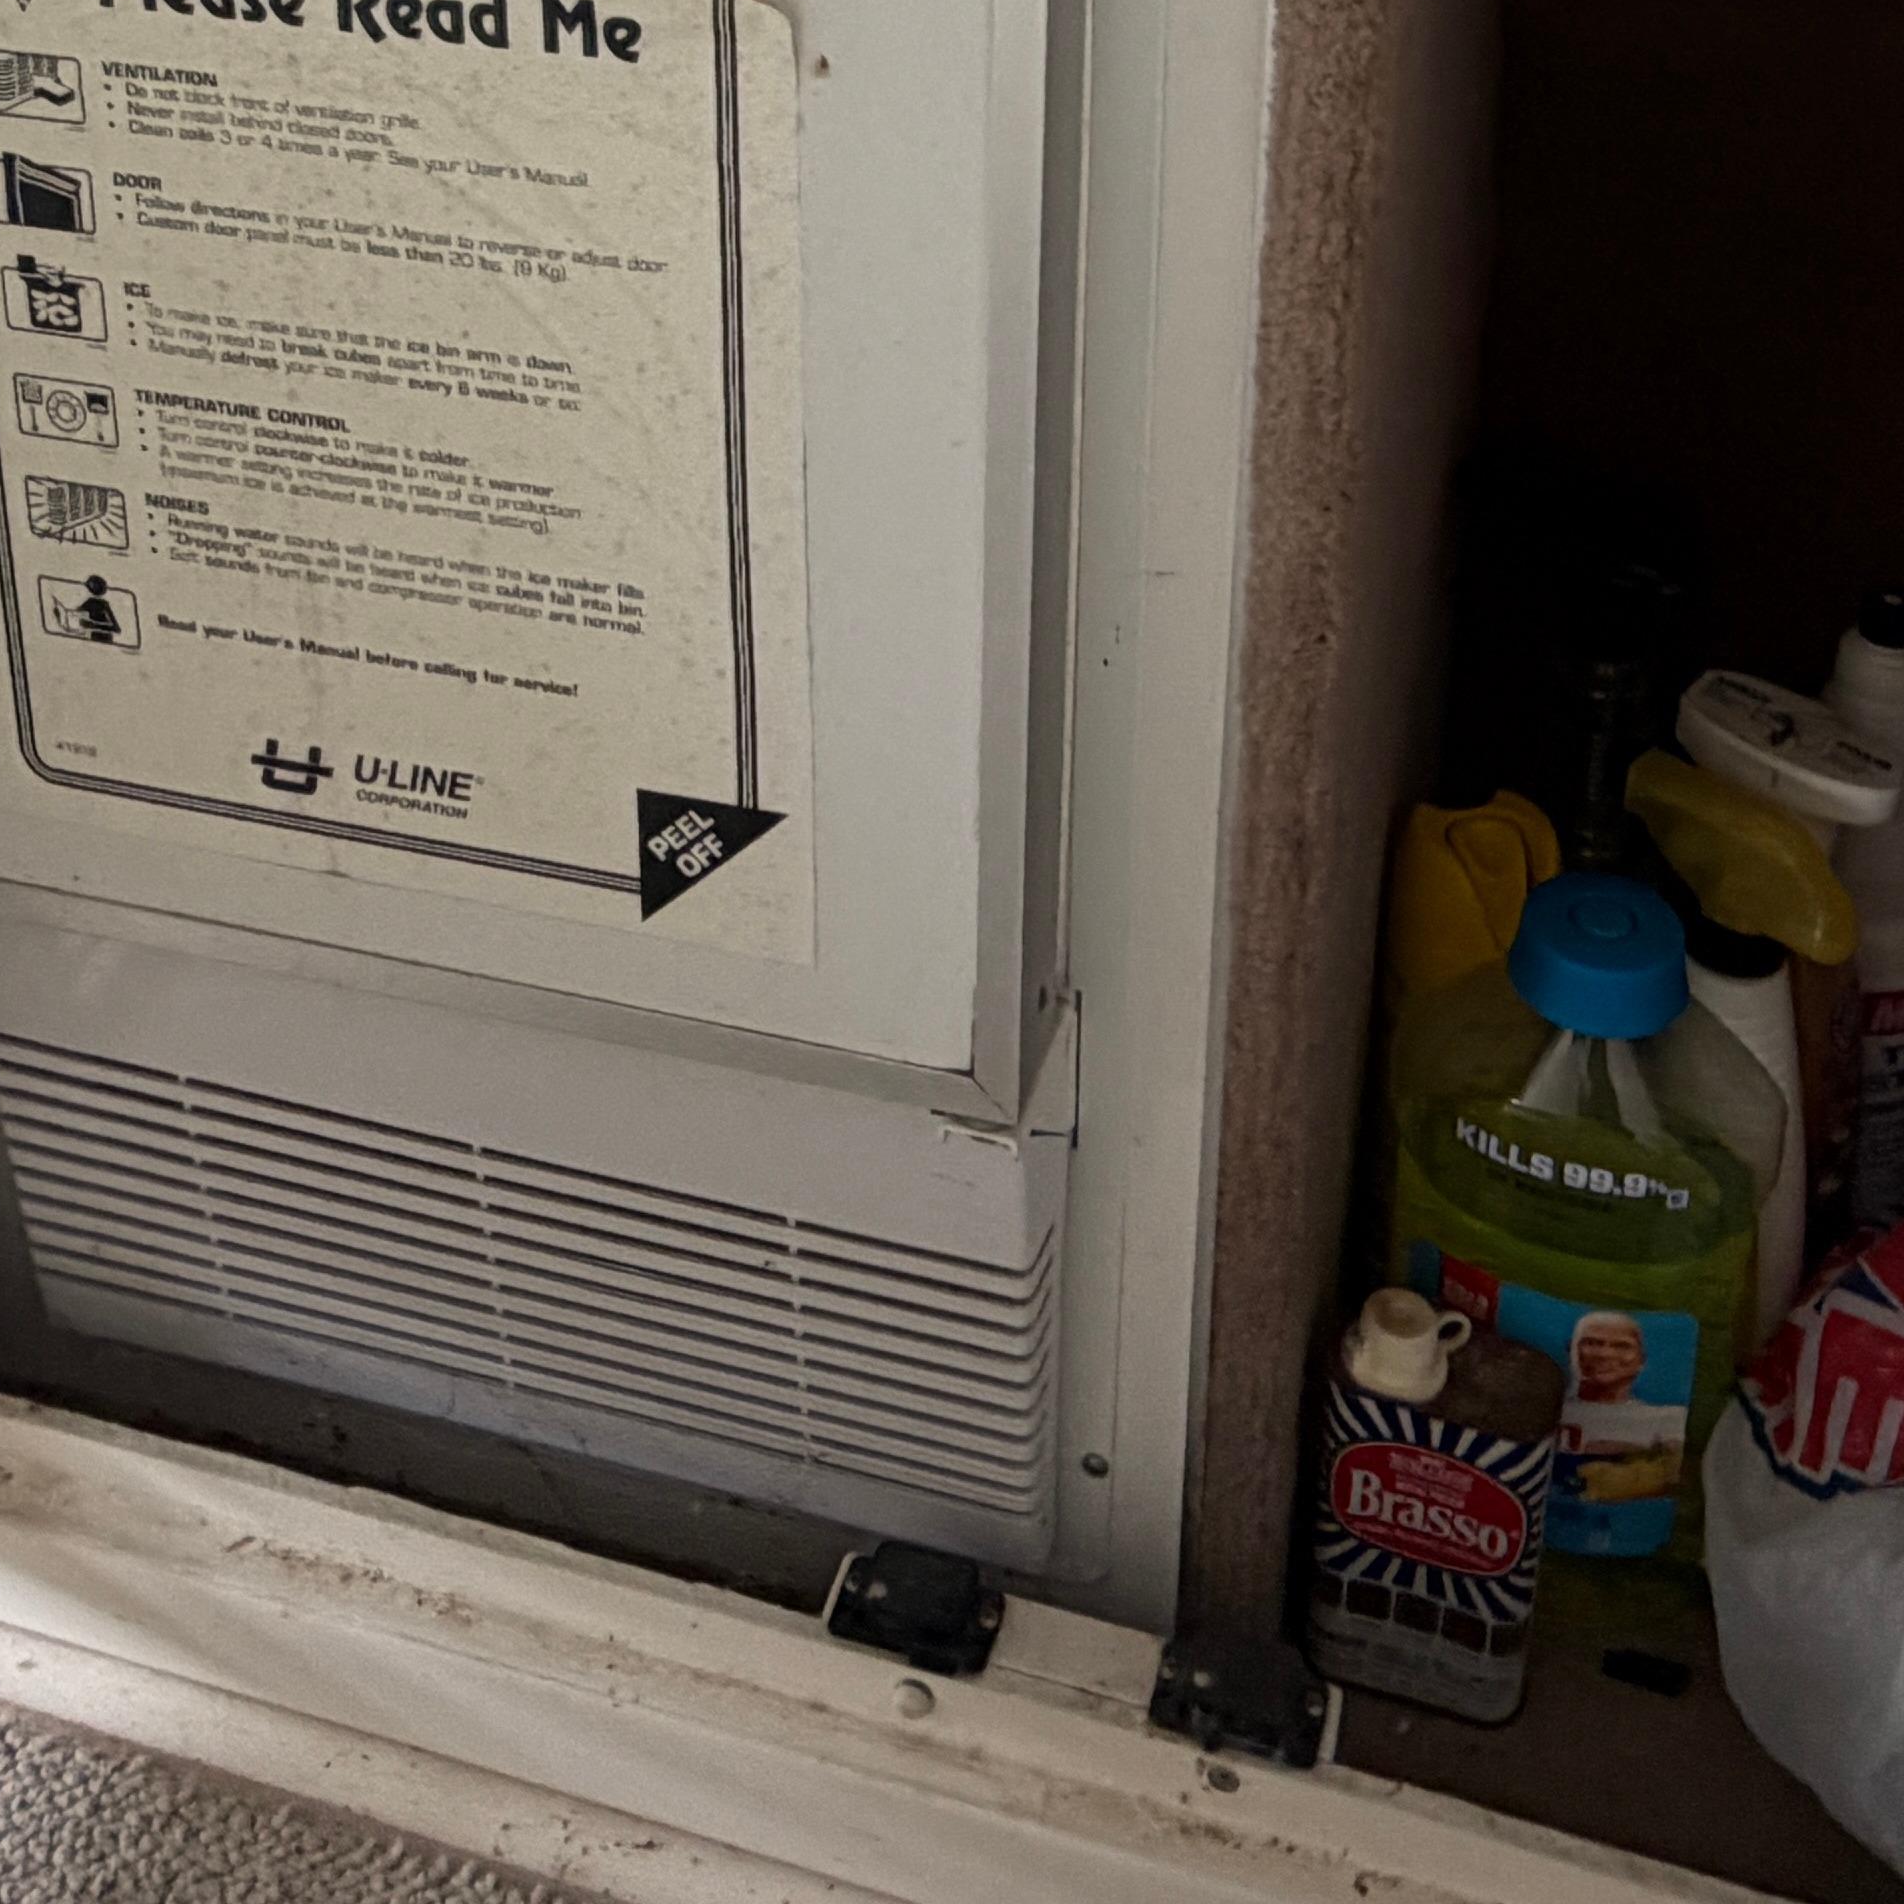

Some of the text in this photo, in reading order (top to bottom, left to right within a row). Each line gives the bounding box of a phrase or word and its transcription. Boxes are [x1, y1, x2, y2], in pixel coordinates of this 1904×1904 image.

[100, 60, 218, 87] VENTILATION
[126, 100, 175, 117] Never
[128, 119, 174, 136] Clean
[424, 156, 461, 171] your
[465, 159, 520, 176] User's
[112, 171, 162, 192] DOOR
[189, 201, 270, 222] directions
[571, 250, 622, 268] adjust
[204, 221, 242, 237] door
[404, 246, 444, 262] than
[448, 251, 474, 266] 20
[122, 282, 151, 298] ICE
[435, 342, 461, 356] bin
[466, 348, 502, 362] arm
[407, 377, 453, 397] every
[474, 387, 529, 403] weeks
[133, 388, 352, 435] TEMPERATURE CONTROL
[145, 492, 210, 515] NOISES
[527, 570, 552, 584] ice
[555, 576, 611, 593] maker
[202, 624, 239, 639] your
[299, 638, 360, 659] Manual
[365, 649, 418, 669] before
[424, 661, 478, 684] calling
[482, 669, 509, 684] for
[513, 677, 579, 696] service!
[355, 787, 469, 820] CORPORATION
[646, 808, 716, 863] PEEL
[675, 833, 725, 880] OFF
[1455, 1115, 1556, 1183] KILLS
[1346, 1467, 1509, 1560] Brasso
